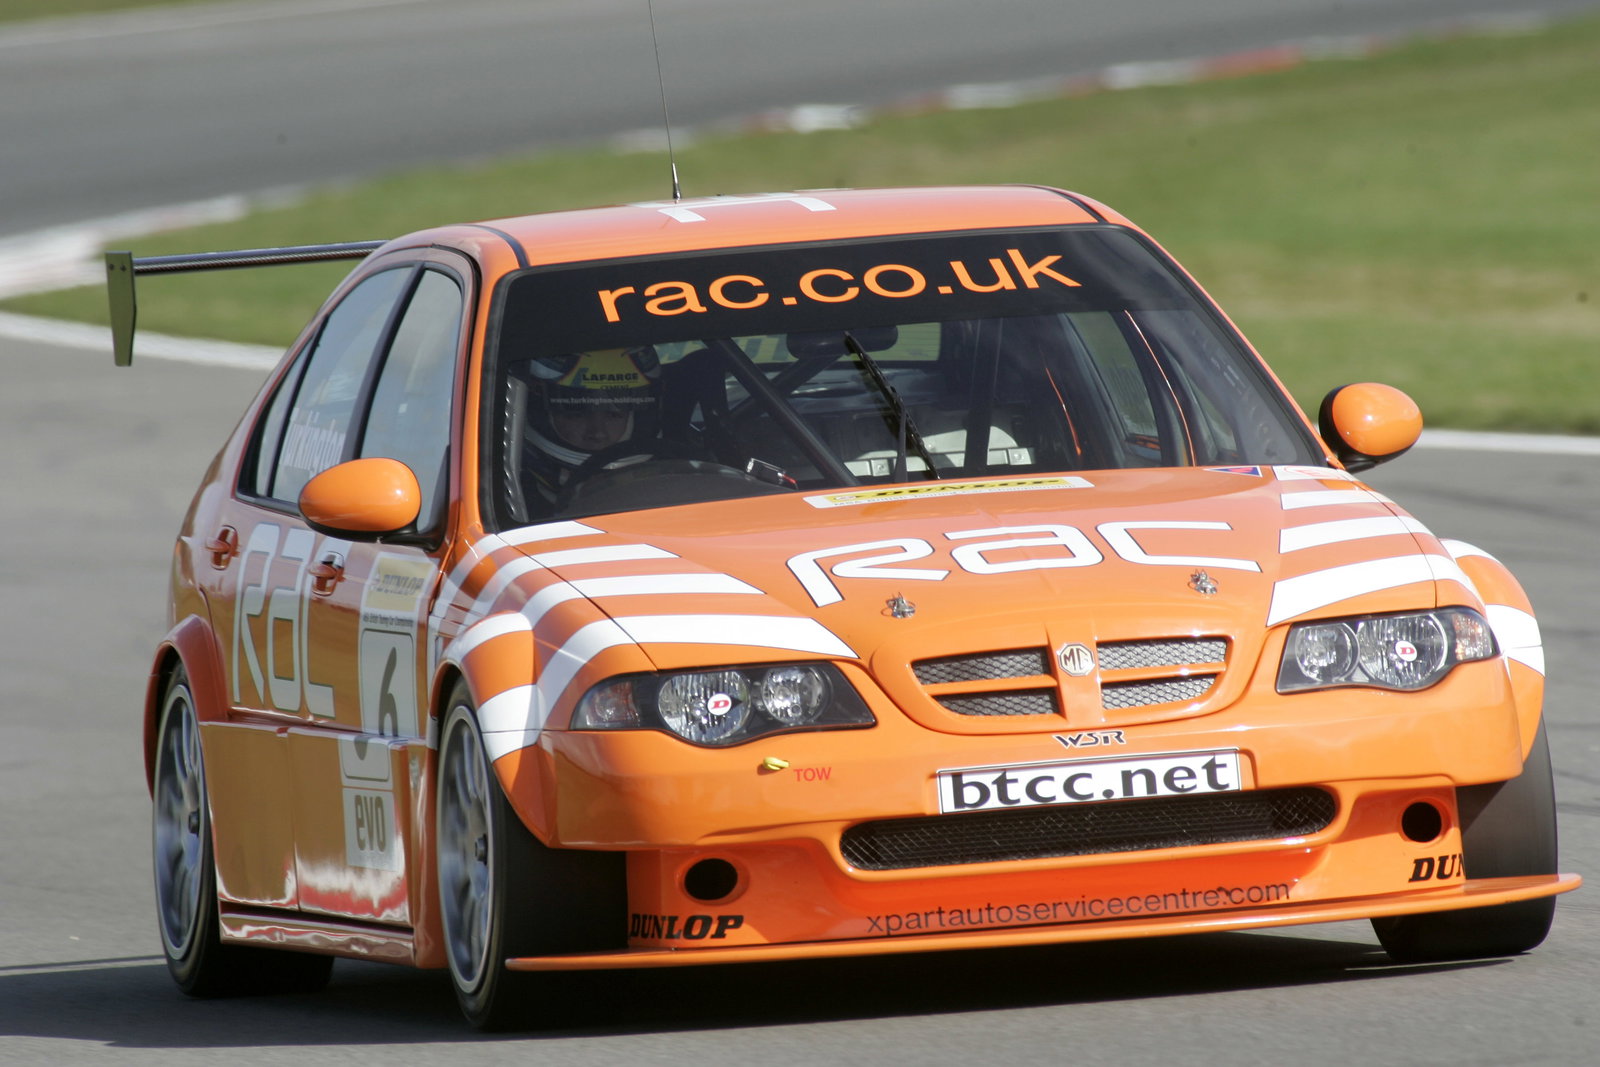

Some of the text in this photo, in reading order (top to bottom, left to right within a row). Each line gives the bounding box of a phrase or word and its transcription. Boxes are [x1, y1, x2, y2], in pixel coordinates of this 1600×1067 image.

[599, 248, 1082, 323] rac.co.uk
[583, 373, 639, 381] LAFARGE
[352, 646, 399, 761] 6
[1055, 731, 1125, 747] WSR
[793, 767, 832, 782] TOW
[952, 755, 1233, 811] btcc.net
[355, 795, 387, 853] evo
[631, 914, 744, 940] DUNLOP
[866, 882, 1291, 938] xpartautoservicecentre.com
